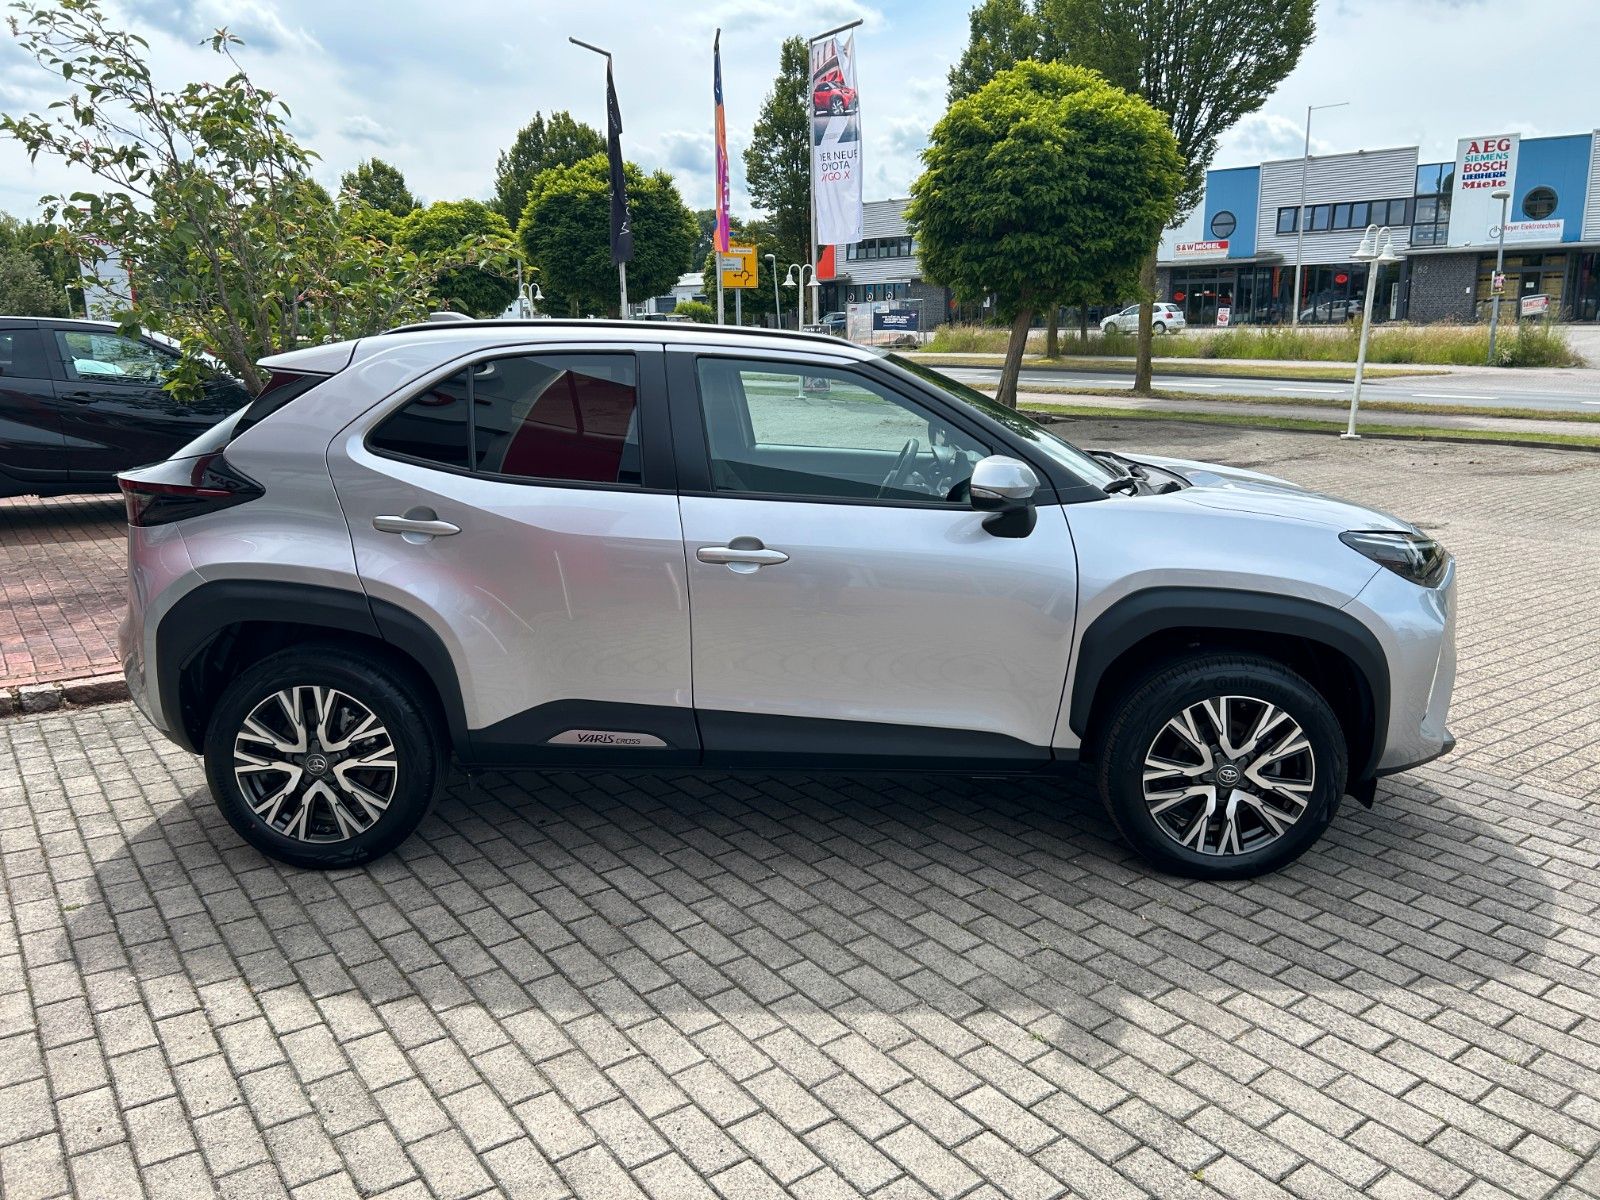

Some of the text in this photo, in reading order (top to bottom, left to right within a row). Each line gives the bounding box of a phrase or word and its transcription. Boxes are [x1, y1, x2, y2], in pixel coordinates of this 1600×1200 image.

[1466, 138, 1511, 154] AEG
[834, 150, 857, 160] NEUE
[1465, 152, 1509, 162] SIEMENS
[822, 161, 850, 172] OYOTA
[1463, 161, 1508, 173] BOSCH
[1462, 171, 1506, 180] LIEBHERR
[1462, 180, 1506, 189] Miele
[1521, 222, 1560, 230] Elektrotechnik
